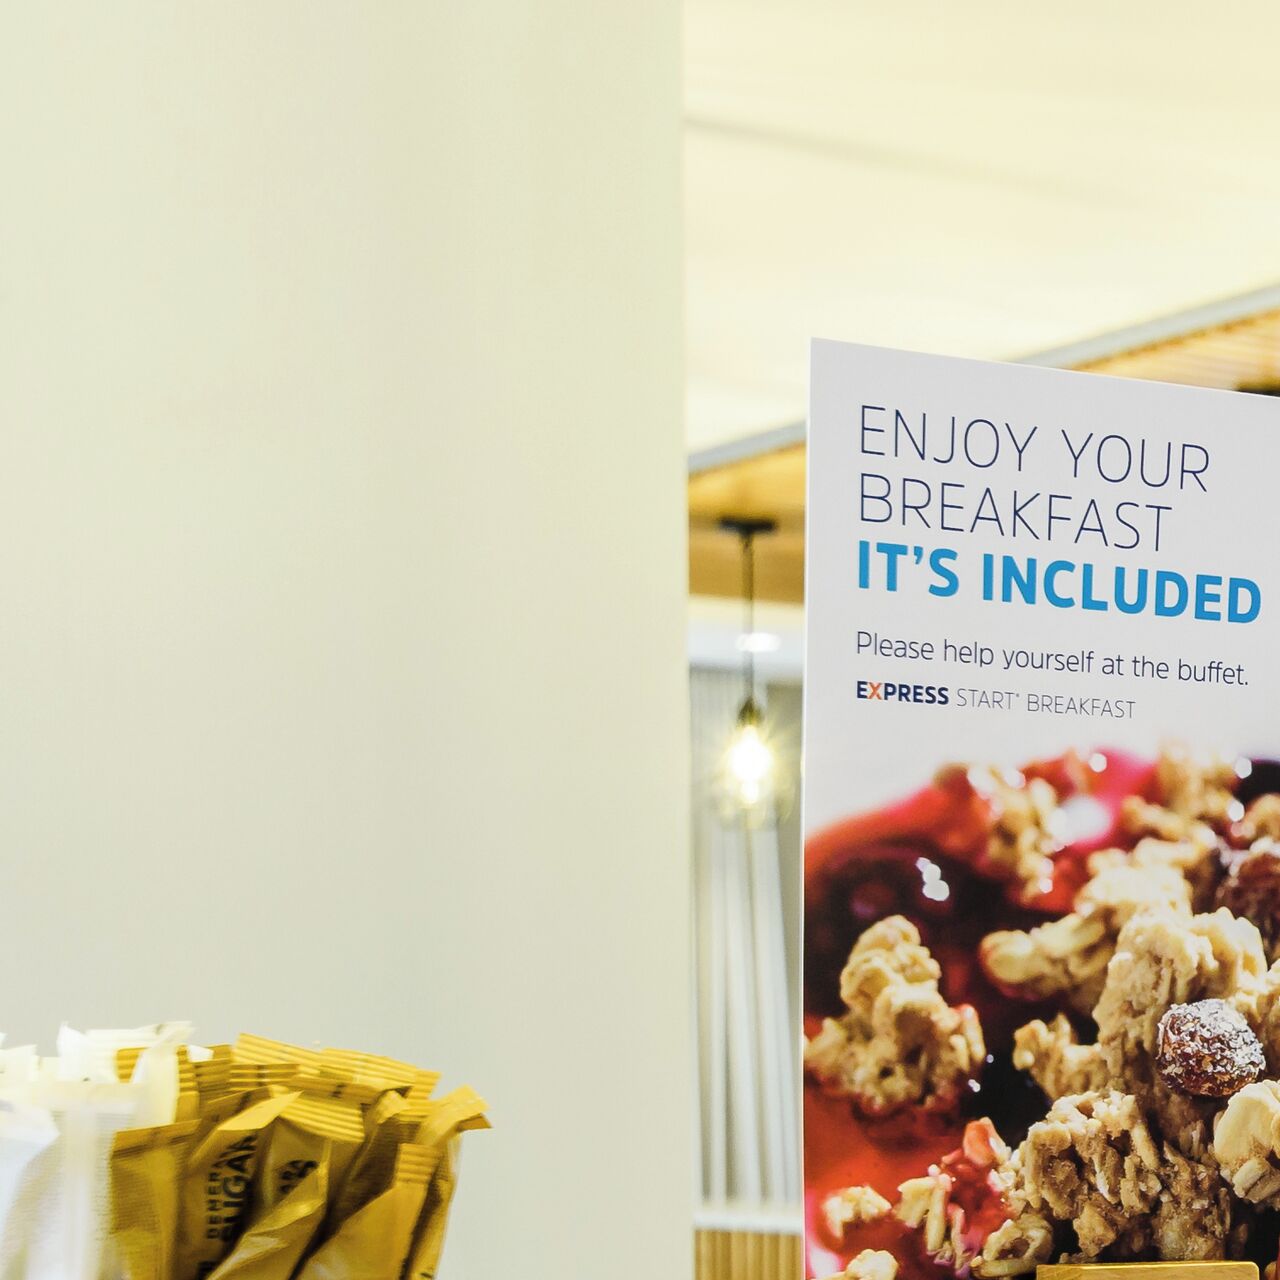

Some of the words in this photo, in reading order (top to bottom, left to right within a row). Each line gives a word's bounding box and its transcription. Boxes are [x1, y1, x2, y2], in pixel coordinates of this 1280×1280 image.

[859, 404, 1039, 472] ENJOY
[1060, 428, 1211, 492] YOUR
[859, 472, 1173, 553] BREAKFAST
[858, 539, 960, 598] IT’S
[982, 552, 1262, 624] INCLUDED
[856, 630, 935, 661] Please
[943, 638, 994, 668] help
[1002, 647, 1095, 674] yourself
[1101, 654, 1125, 677] at
[1131, 655, 1170, 681] the
[1177, 657, 1249, 686] buffet.
[856, 680, 950, 706] EXPRESS
[1027, 693, 1137, 719] BREAKFAST
